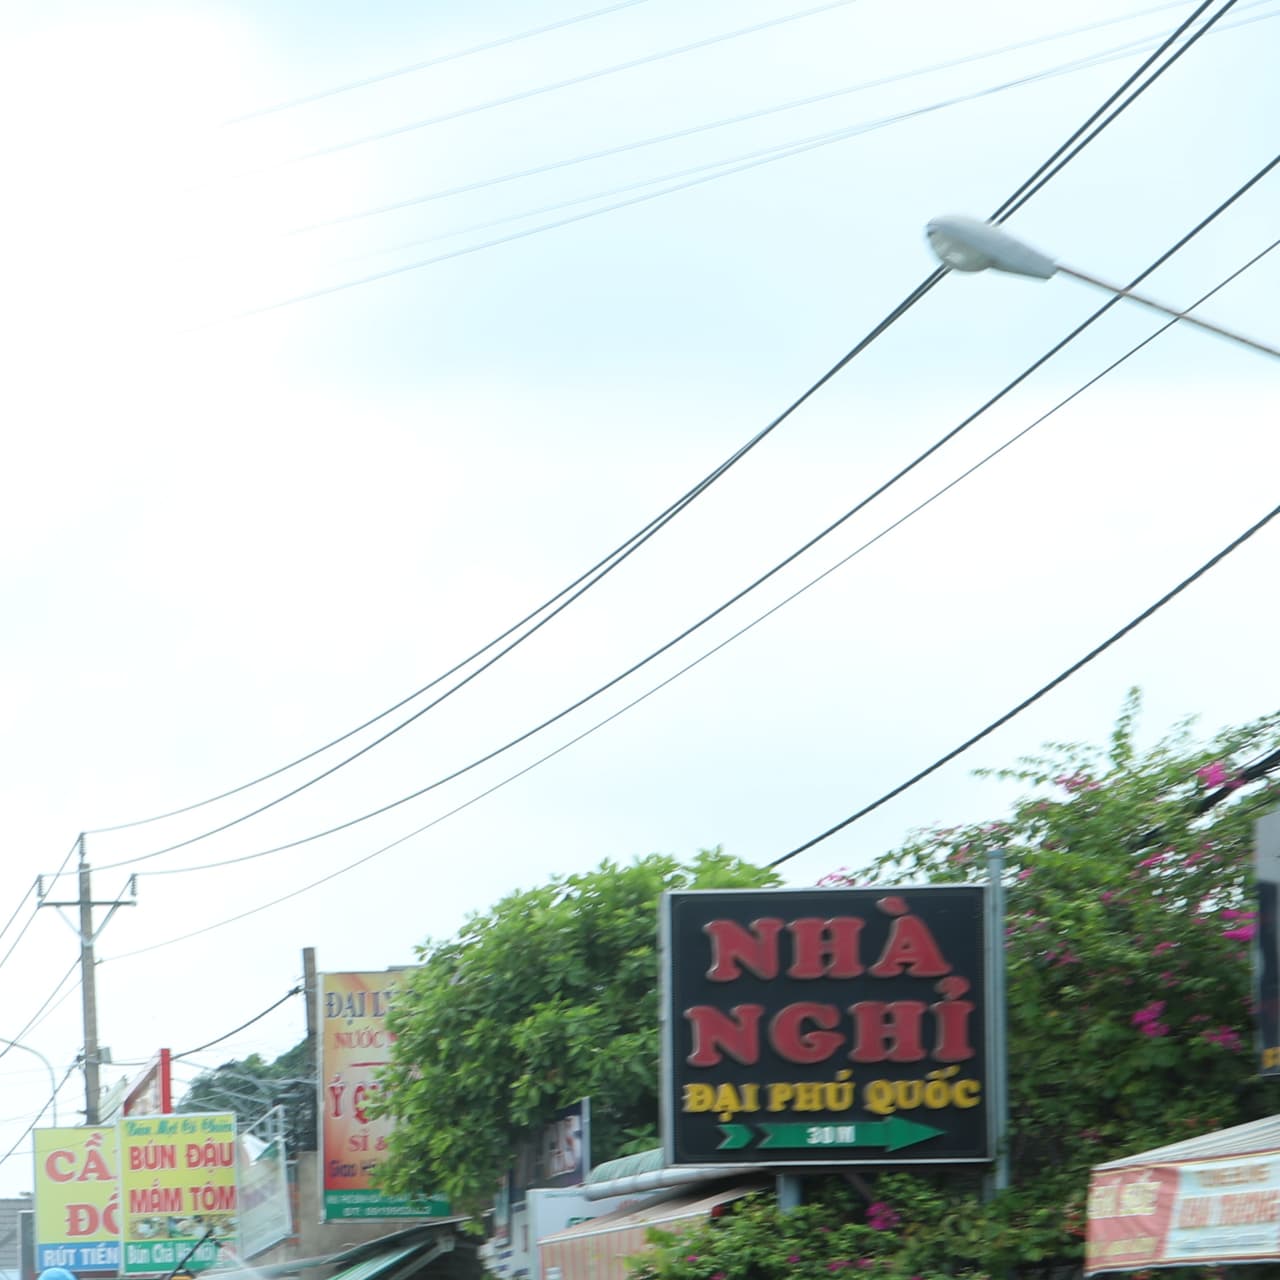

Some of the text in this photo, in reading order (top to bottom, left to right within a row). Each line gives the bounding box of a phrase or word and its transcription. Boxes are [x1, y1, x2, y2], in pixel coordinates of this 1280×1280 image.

[703, 896, 952, 982] NHÀ
[325, 991, 365, 1025] ĐẠI
[683, 976, 976, 1067] NGHỈ
[682, 1065, 981, 1122] ĐẠI PHÚ QUỐC
[129, 1137, 234, 1173] BÚN ĐẬU
[130, 1179, 236, 1213] MẮM TÔM
[43, 1245, 77, 1267] RÚT
